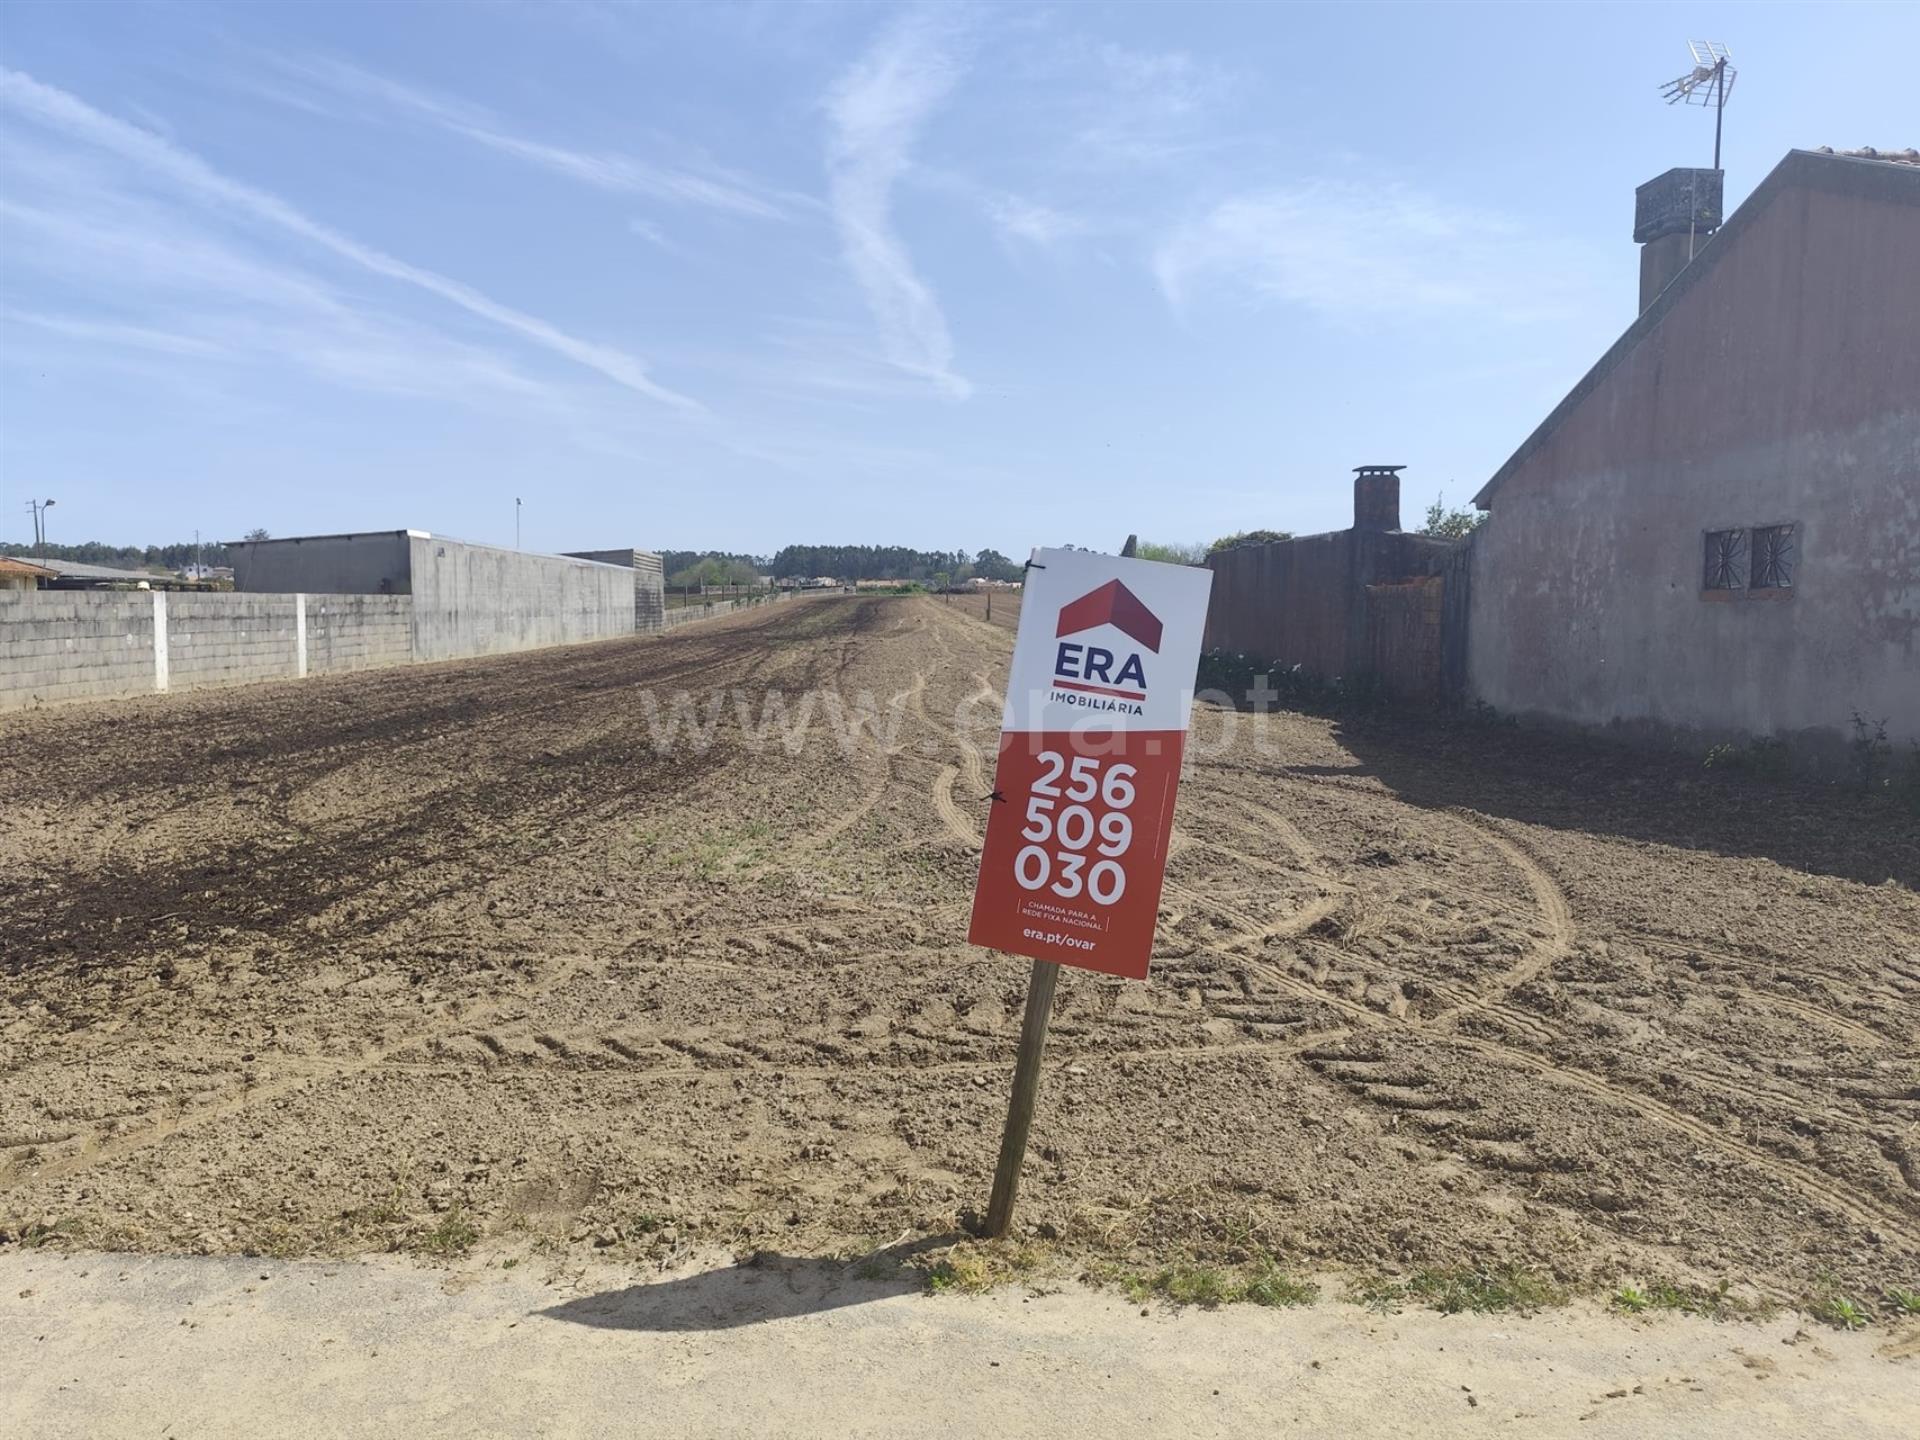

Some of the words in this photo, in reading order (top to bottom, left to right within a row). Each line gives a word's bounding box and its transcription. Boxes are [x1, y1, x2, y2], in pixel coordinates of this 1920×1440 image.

[1055, 642, 1147, 689] ERA
[1050, 691, 1143, 716] IMOBILIÁRIA
[1031, 751, 1137, 809] 256
[1021, 796, 1133, 857] 509
[1014, 845, 1126, 905] 030
[1022, 908, 1042, 918] REDE
[1043, 912, 1061, 922] FIXA
[1062, 917, 1103, 930] NACIONAL
[1028, 901, 1066, 914] CHAMADA
[1067, 909, 1089, 919] PARA
[1023, 928, 1096, 951] era.pt/ovar
